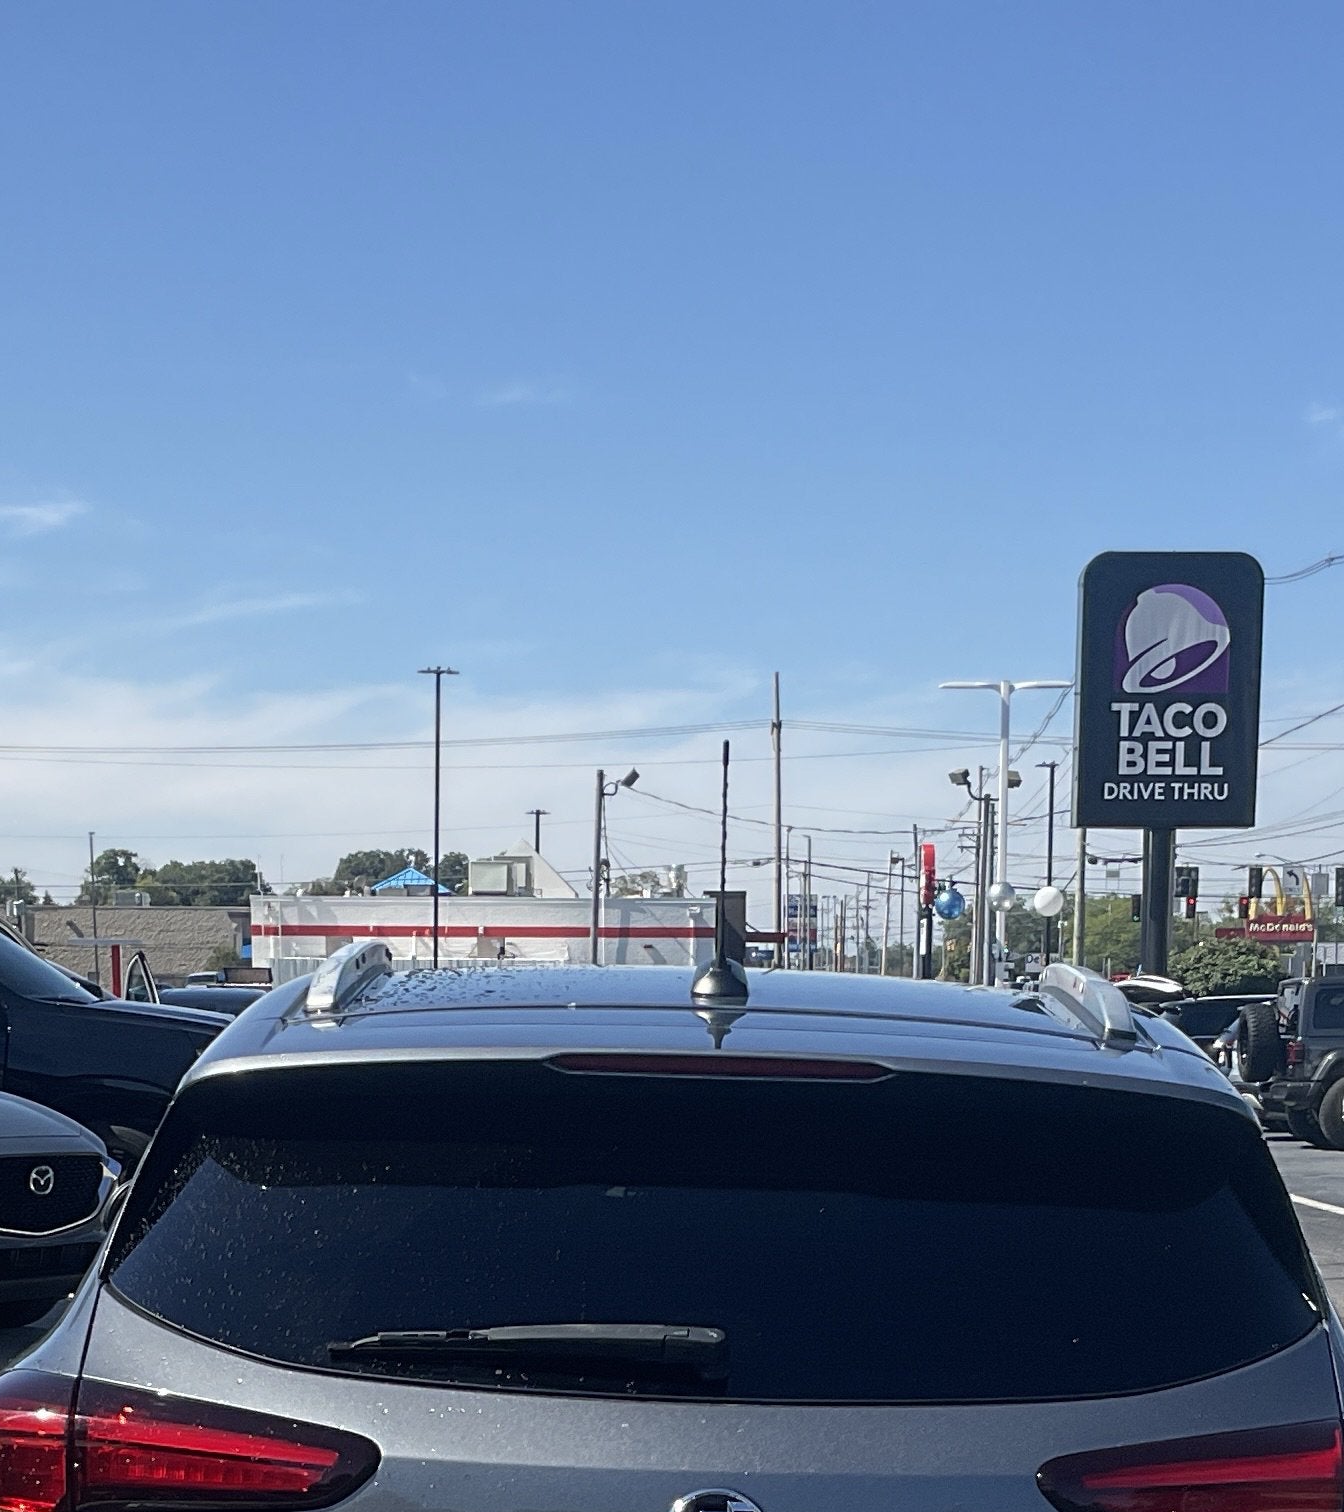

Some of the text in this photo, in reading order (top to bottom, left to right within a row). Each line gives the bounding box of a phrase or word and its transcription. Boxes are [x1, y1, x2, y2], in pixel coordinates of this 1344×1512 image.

[1110, 702, 1227, 738] TACO
[1118, 741, 1224, 776] BELL
[1103, 782, 1229, 800] DRIVE THRU
